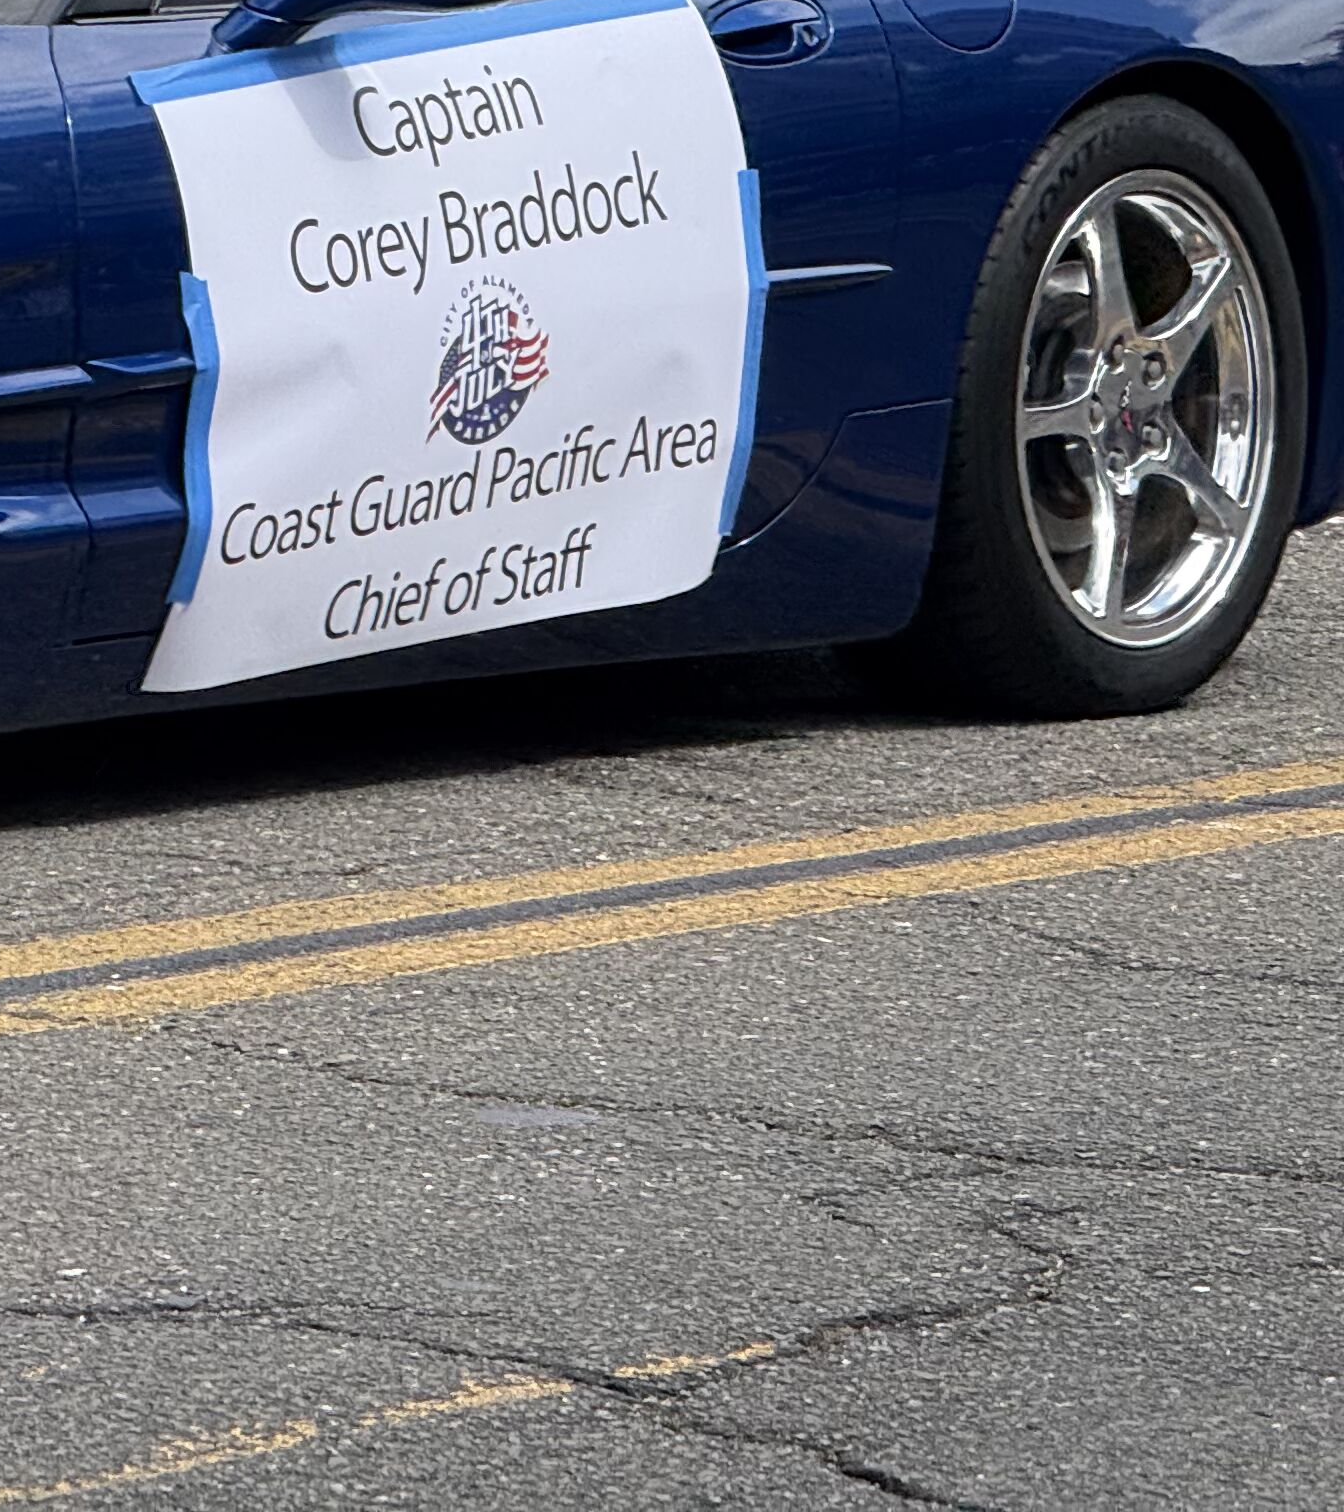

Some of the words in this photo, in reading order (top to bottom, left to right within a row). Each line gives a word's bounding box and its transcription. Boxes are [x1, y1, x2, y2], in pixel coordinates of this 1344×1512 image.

[353, 64, 544, 168] Captain
[290, 218, 429, 294] Corey
[438, 149, 668, 265] Braddock
[441, 302, 458, 348] CITY
[460, 280, 476, 299] OF
[482, 274, 535, 330] ALAMEDA
[461, 294, 515, 372] 4TH
[447, 345, 522, 419] JULY
[220, 489, 343, 566] Coast
[349, 449, 482, 537] Guard
[485, 424, 617, 509] Pacific
[619, 415, 717, 479] Area
[323, 556, 447, 641] Chief
[443, 545, 497, 616] of
[493, 522, 599, 607] Staff
